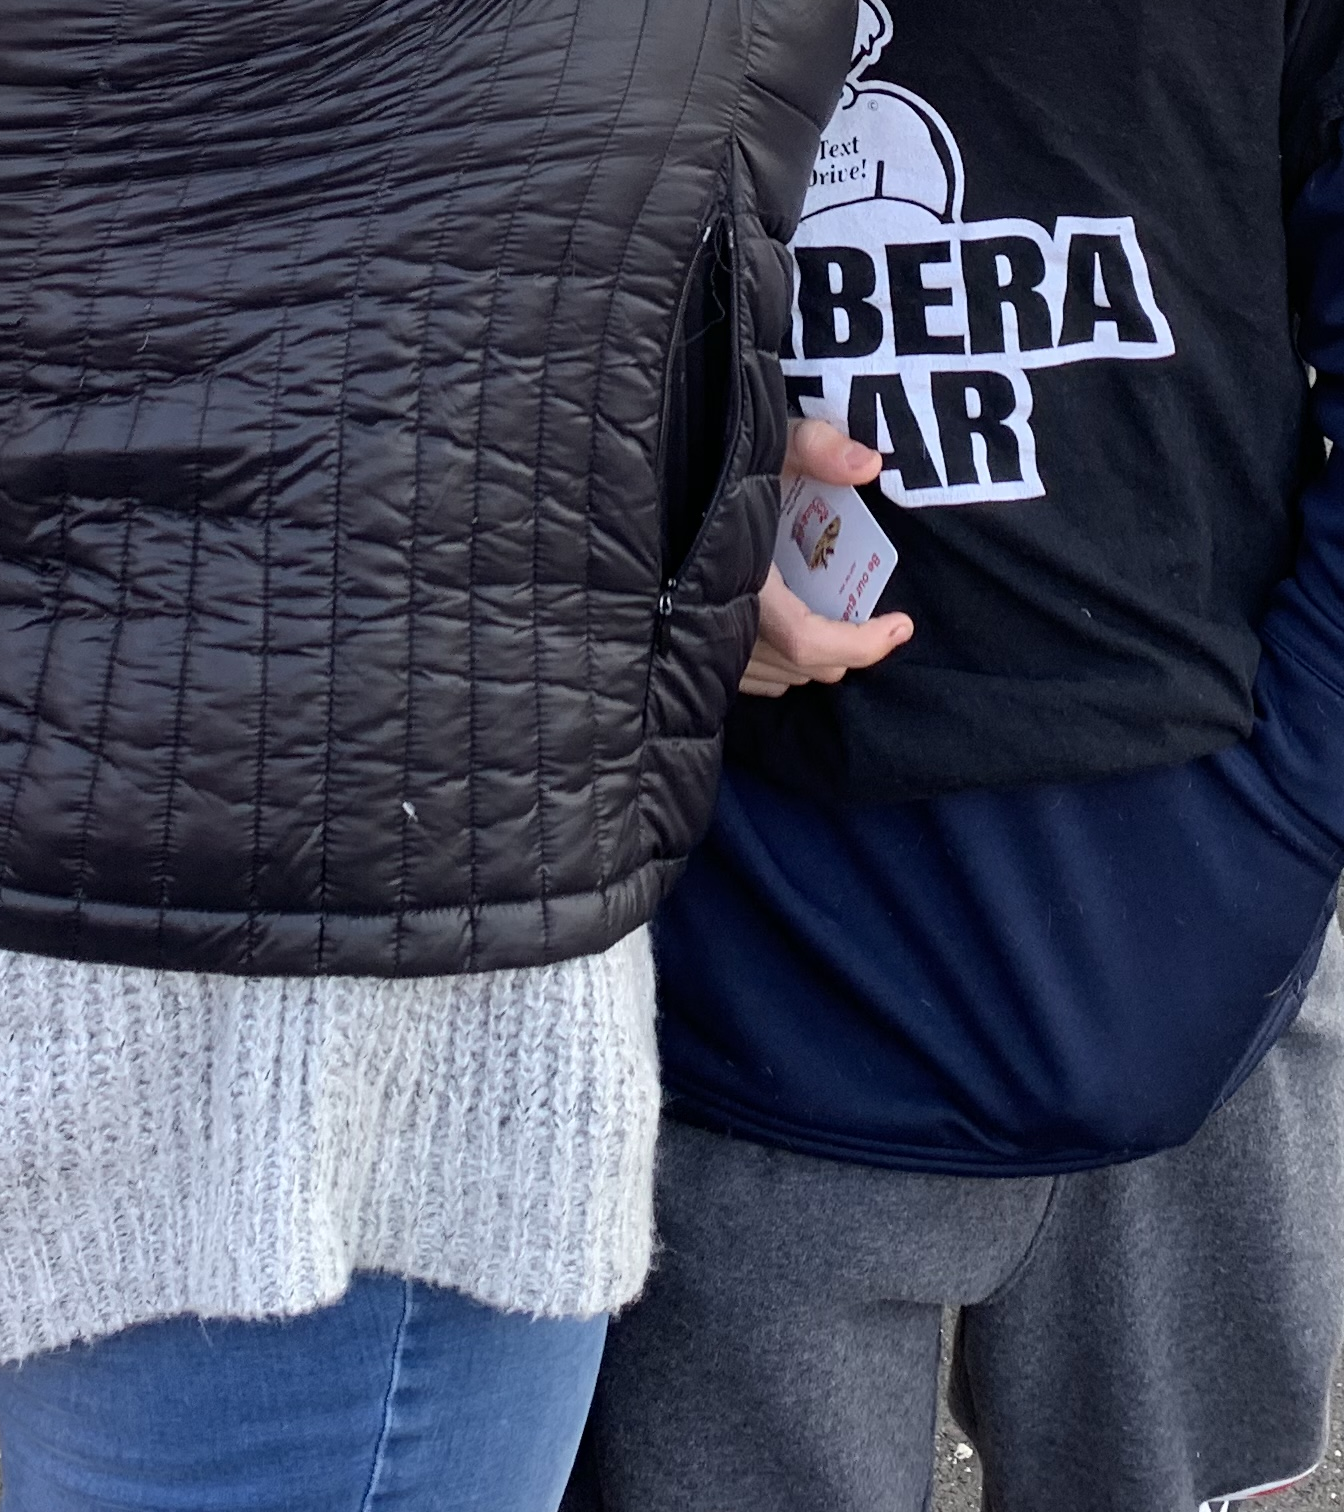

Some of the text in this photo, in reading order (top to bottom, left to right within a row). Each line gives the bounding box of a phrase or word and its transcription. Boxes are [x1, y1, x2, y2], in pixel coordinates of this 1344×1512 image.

[820, 136, 859, 160] Text
[779, 233, 1158, 360] BERA
[786, 370, 1024, 491] AR
[840, 593, 857, 622] gue
